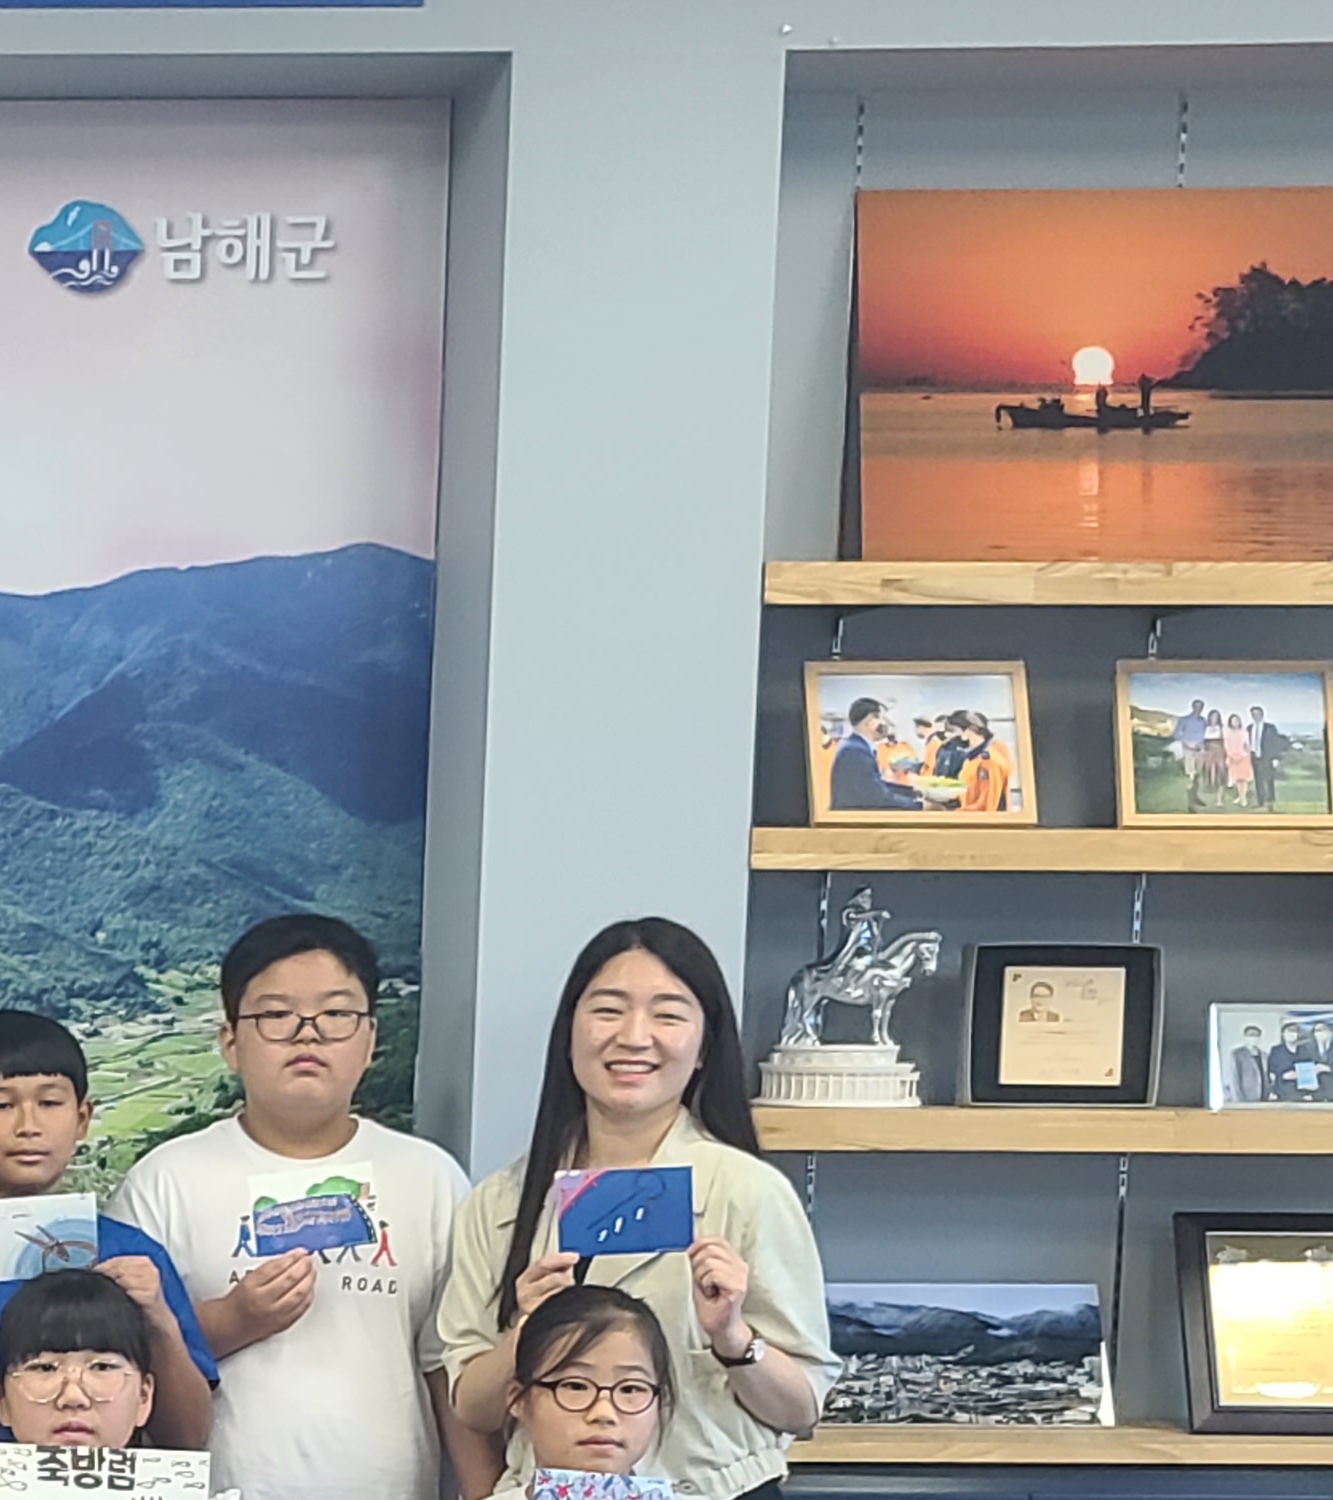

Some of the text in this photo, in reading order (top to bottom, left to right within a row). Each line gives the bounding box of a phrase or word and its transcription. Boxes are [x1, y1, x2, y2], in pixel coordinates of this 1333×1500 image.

[156, 211, 336, 281] 남해군
[341, 1275, 399, 1295] ROAD
[35, 1444, 138, 1491] 죽방렴
